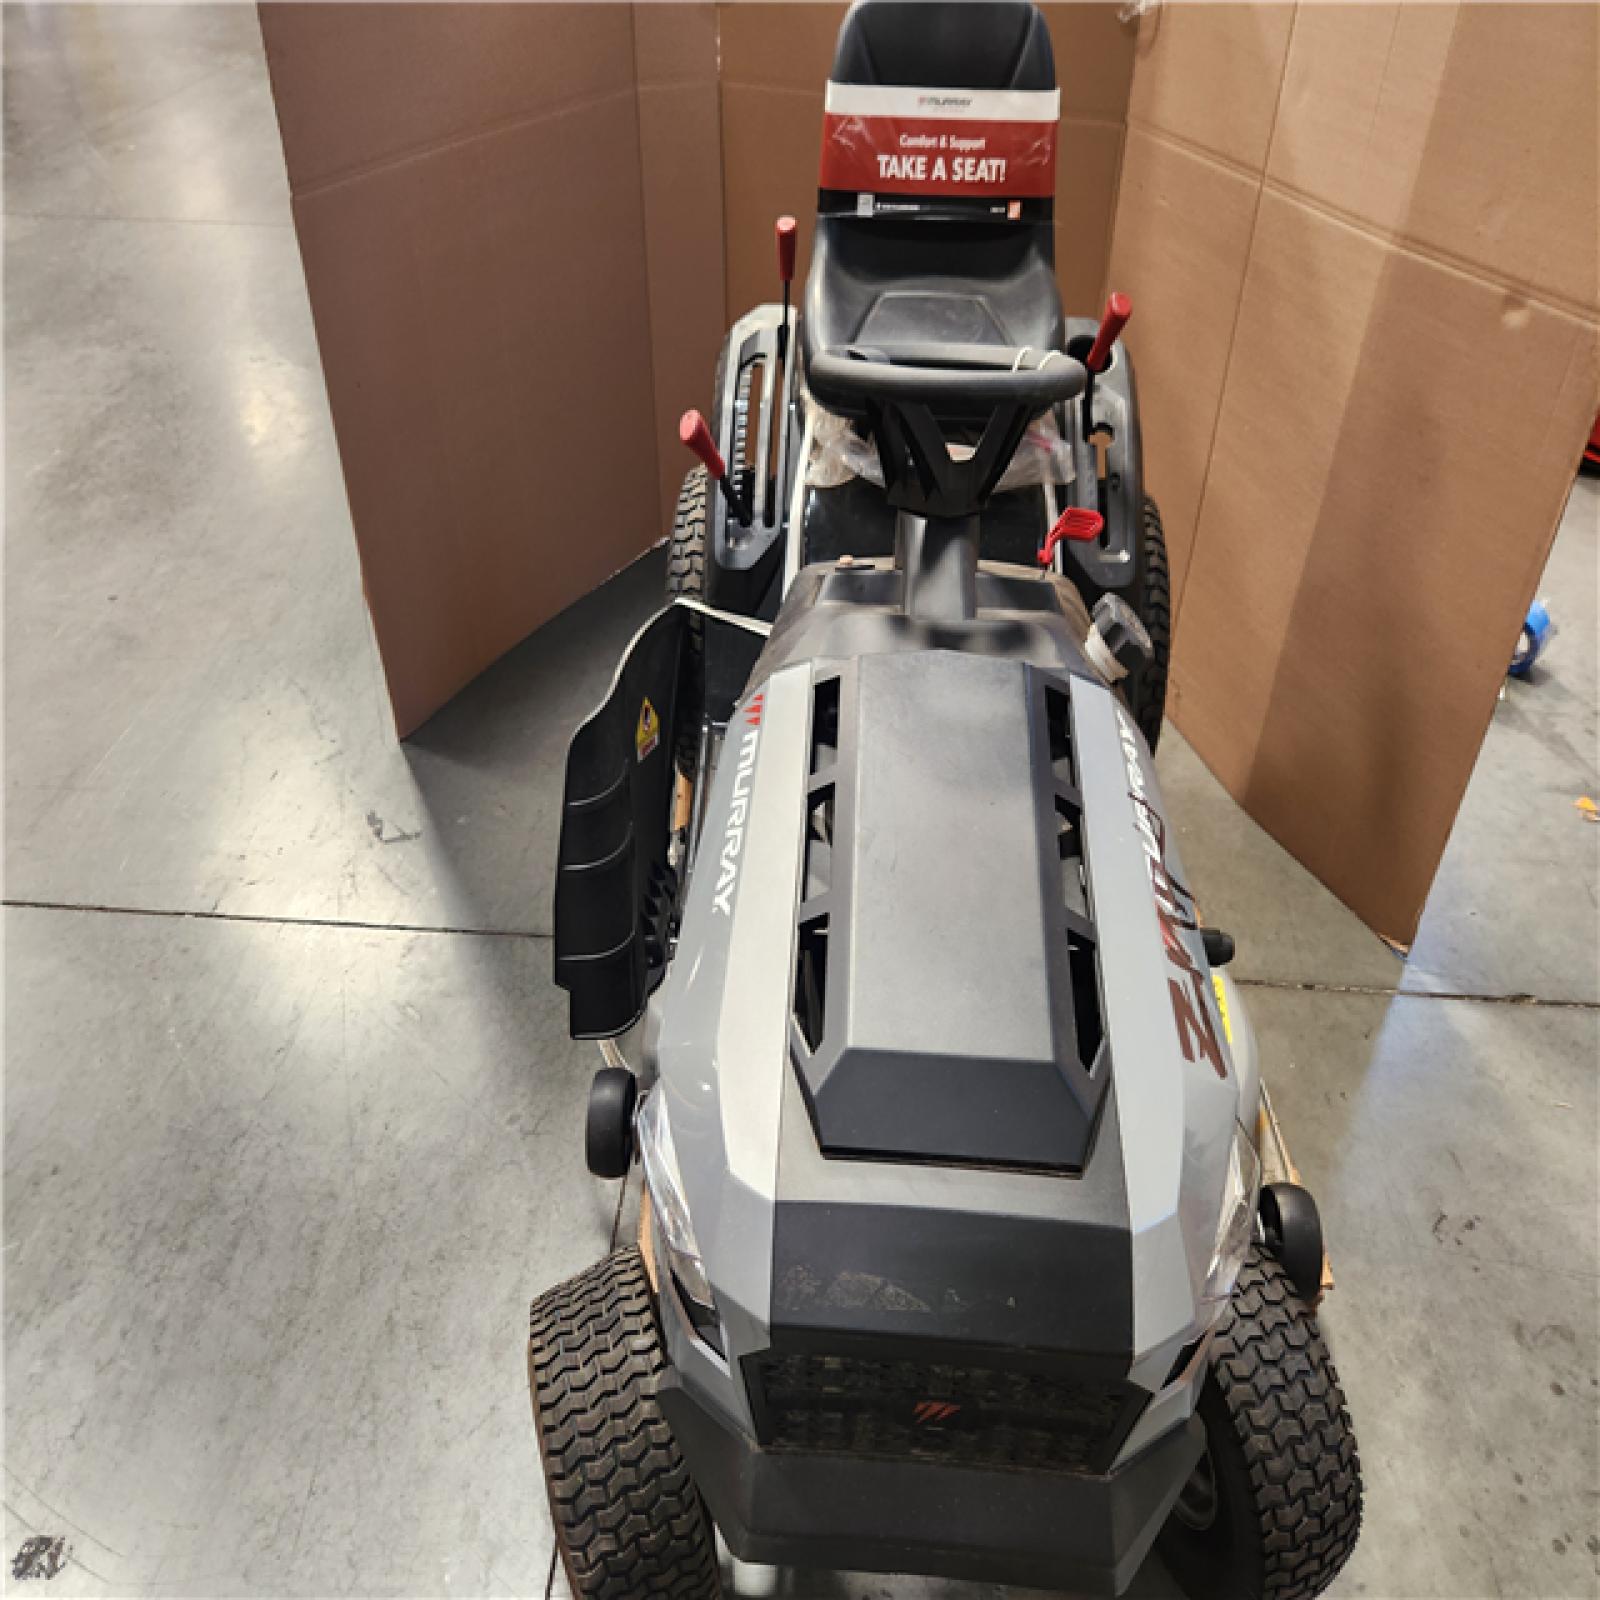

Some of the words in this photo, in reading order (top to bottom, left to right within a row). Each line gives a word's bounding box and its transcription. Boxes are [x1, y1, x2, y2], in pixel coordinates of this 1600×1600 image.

[877, 154, 927, 180] TAKE
[932, 156, 947, 181] A
[952, 157, 1006, 183] SEAT!
[711, 729, 759, 916] MURRAY
